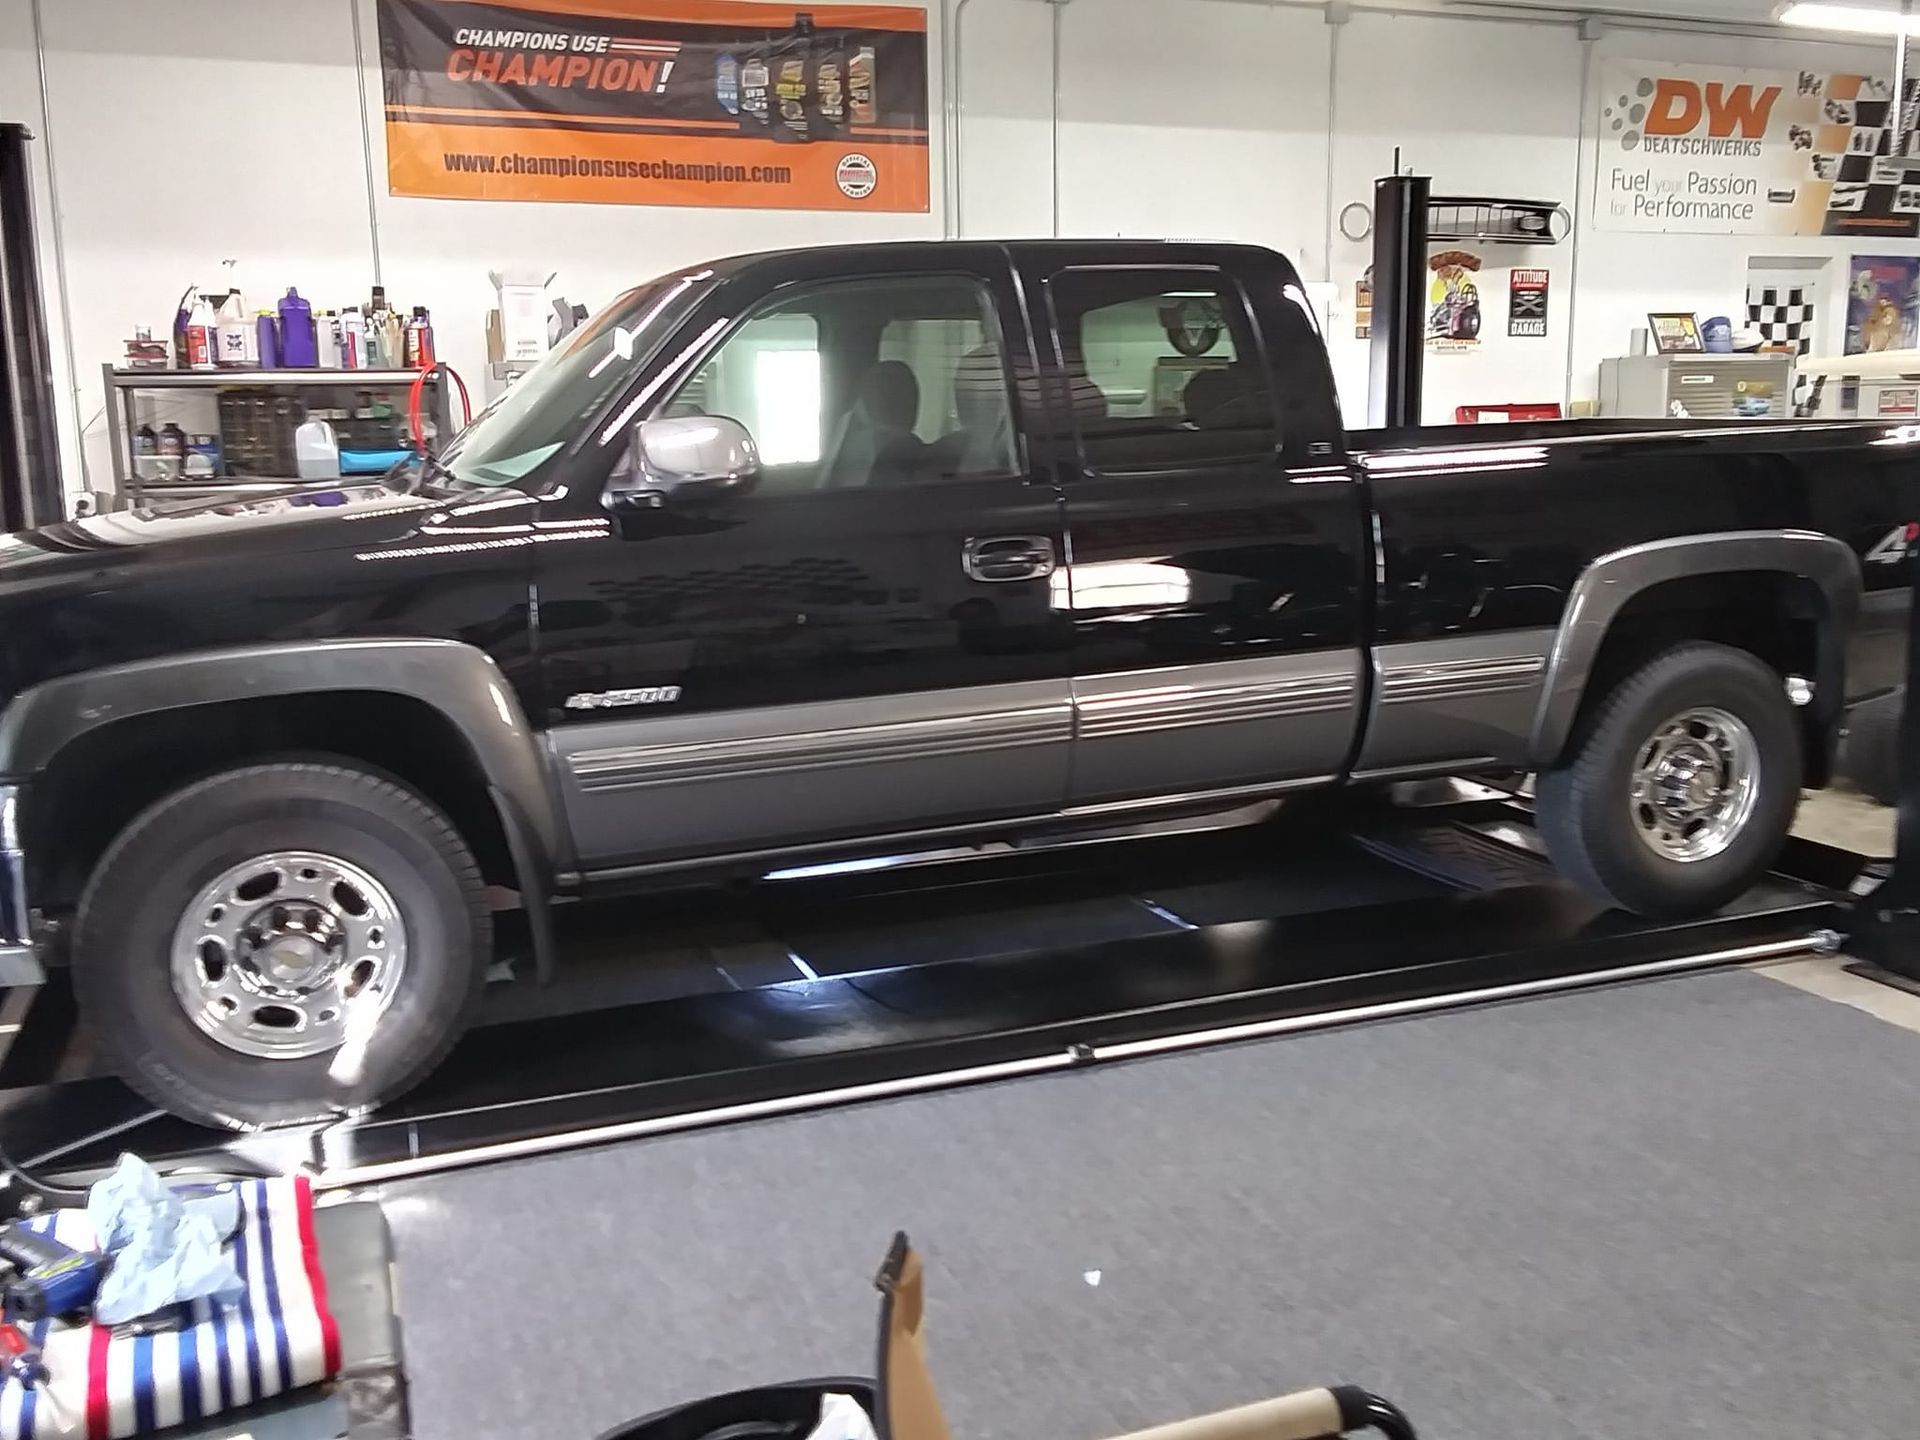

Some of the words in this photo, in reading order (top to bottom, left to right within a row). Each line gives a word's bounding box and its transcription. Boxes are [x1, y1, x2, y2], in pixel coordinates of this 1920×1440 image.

[455, 28, 568, 51] CHAMPIONS
[571, 35, 610, 53] USE
[447, 48, 675, 93] CHAMPION!
[1644, 78, 1783, 138] DW
[1644, 136, 1763, 157] DEATSCHWERKS
[444, 153, 792, 184] www.championsusechampion.com
[1611, 167, 1651, 192] Fuel
[1654, 177, 1683, 197] your
[1687, 170, 1758, 196] Passion
[1610, 198, 1628, 217] for
[1633, 193, 1755, 220] Performance
[1513, 271, 1548, 283] ATTITUDE
